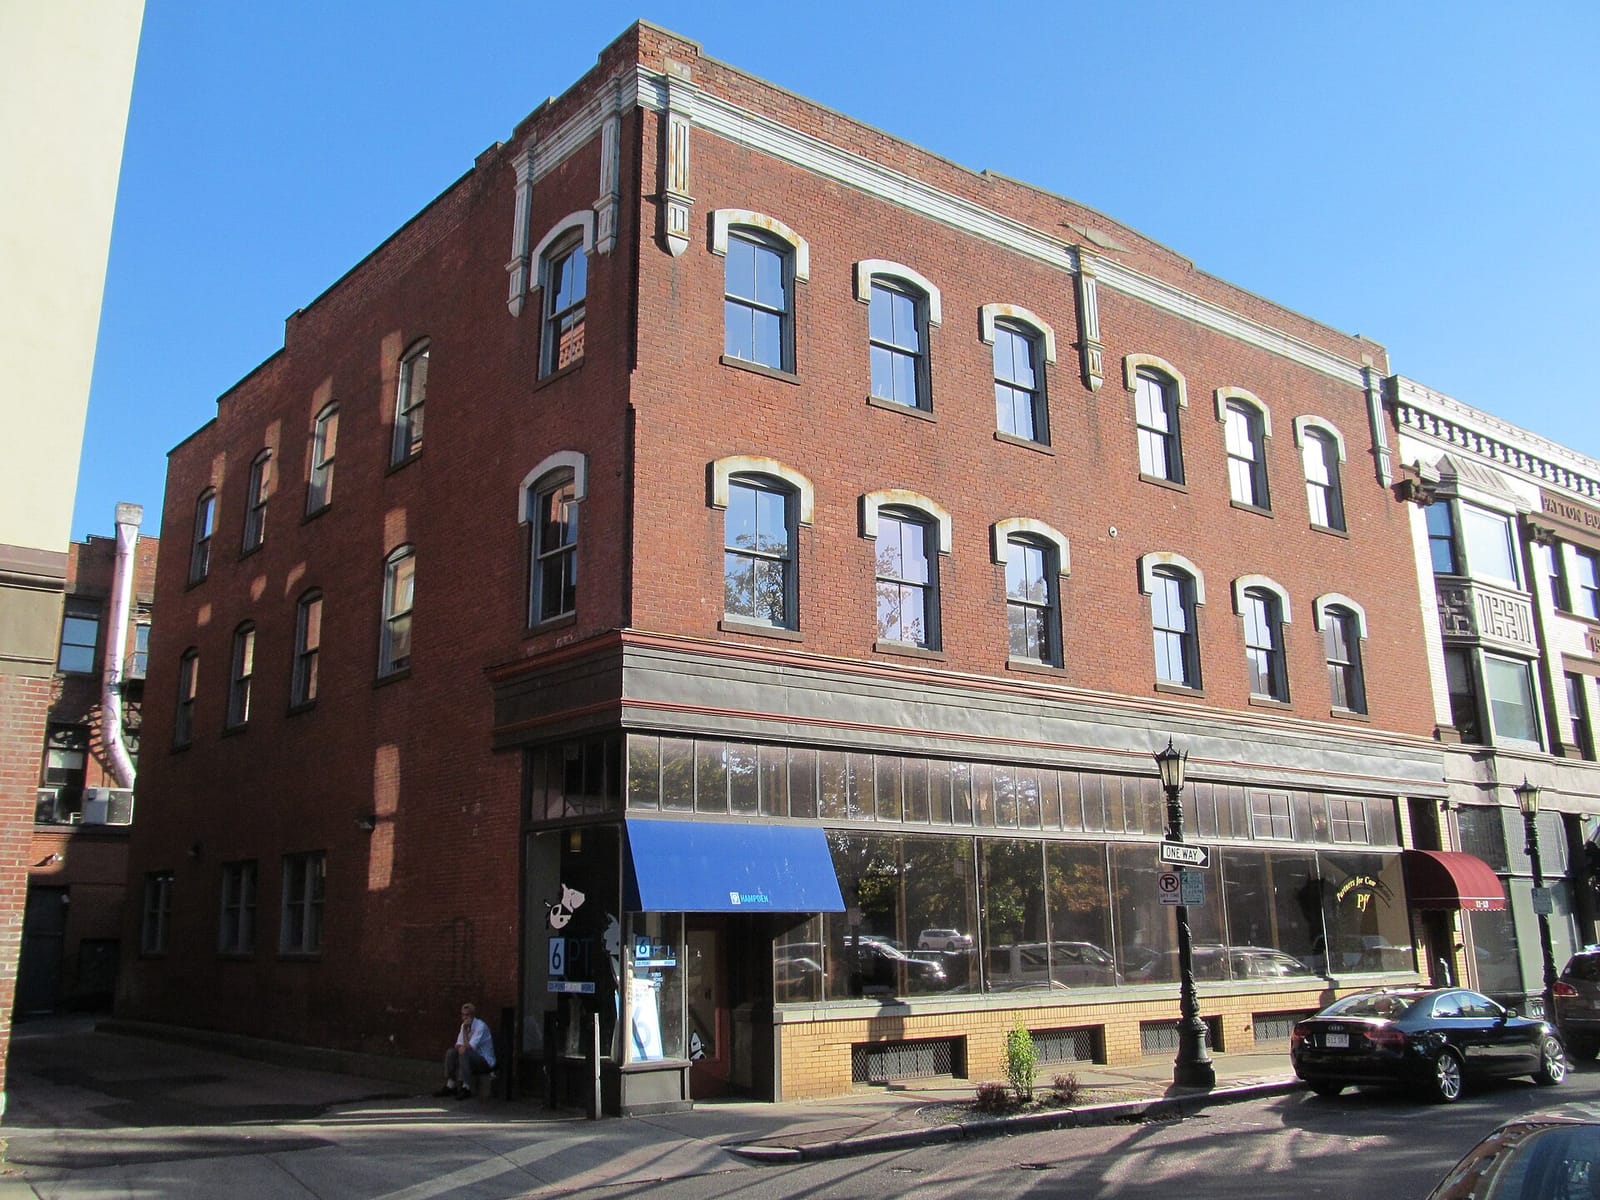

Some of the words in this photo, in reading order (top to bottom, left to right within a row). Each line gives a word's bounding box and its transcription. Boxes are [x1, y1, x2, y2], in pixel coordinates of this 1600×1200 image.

[1541, 495, 1582, 523] PATTON
[1166, 846, 1181, 859] ONE
[1182, 850, 1198, 861] WAY
[1337, 879, 1355, 902] Partners
[552, 942, 562, 970] 6
